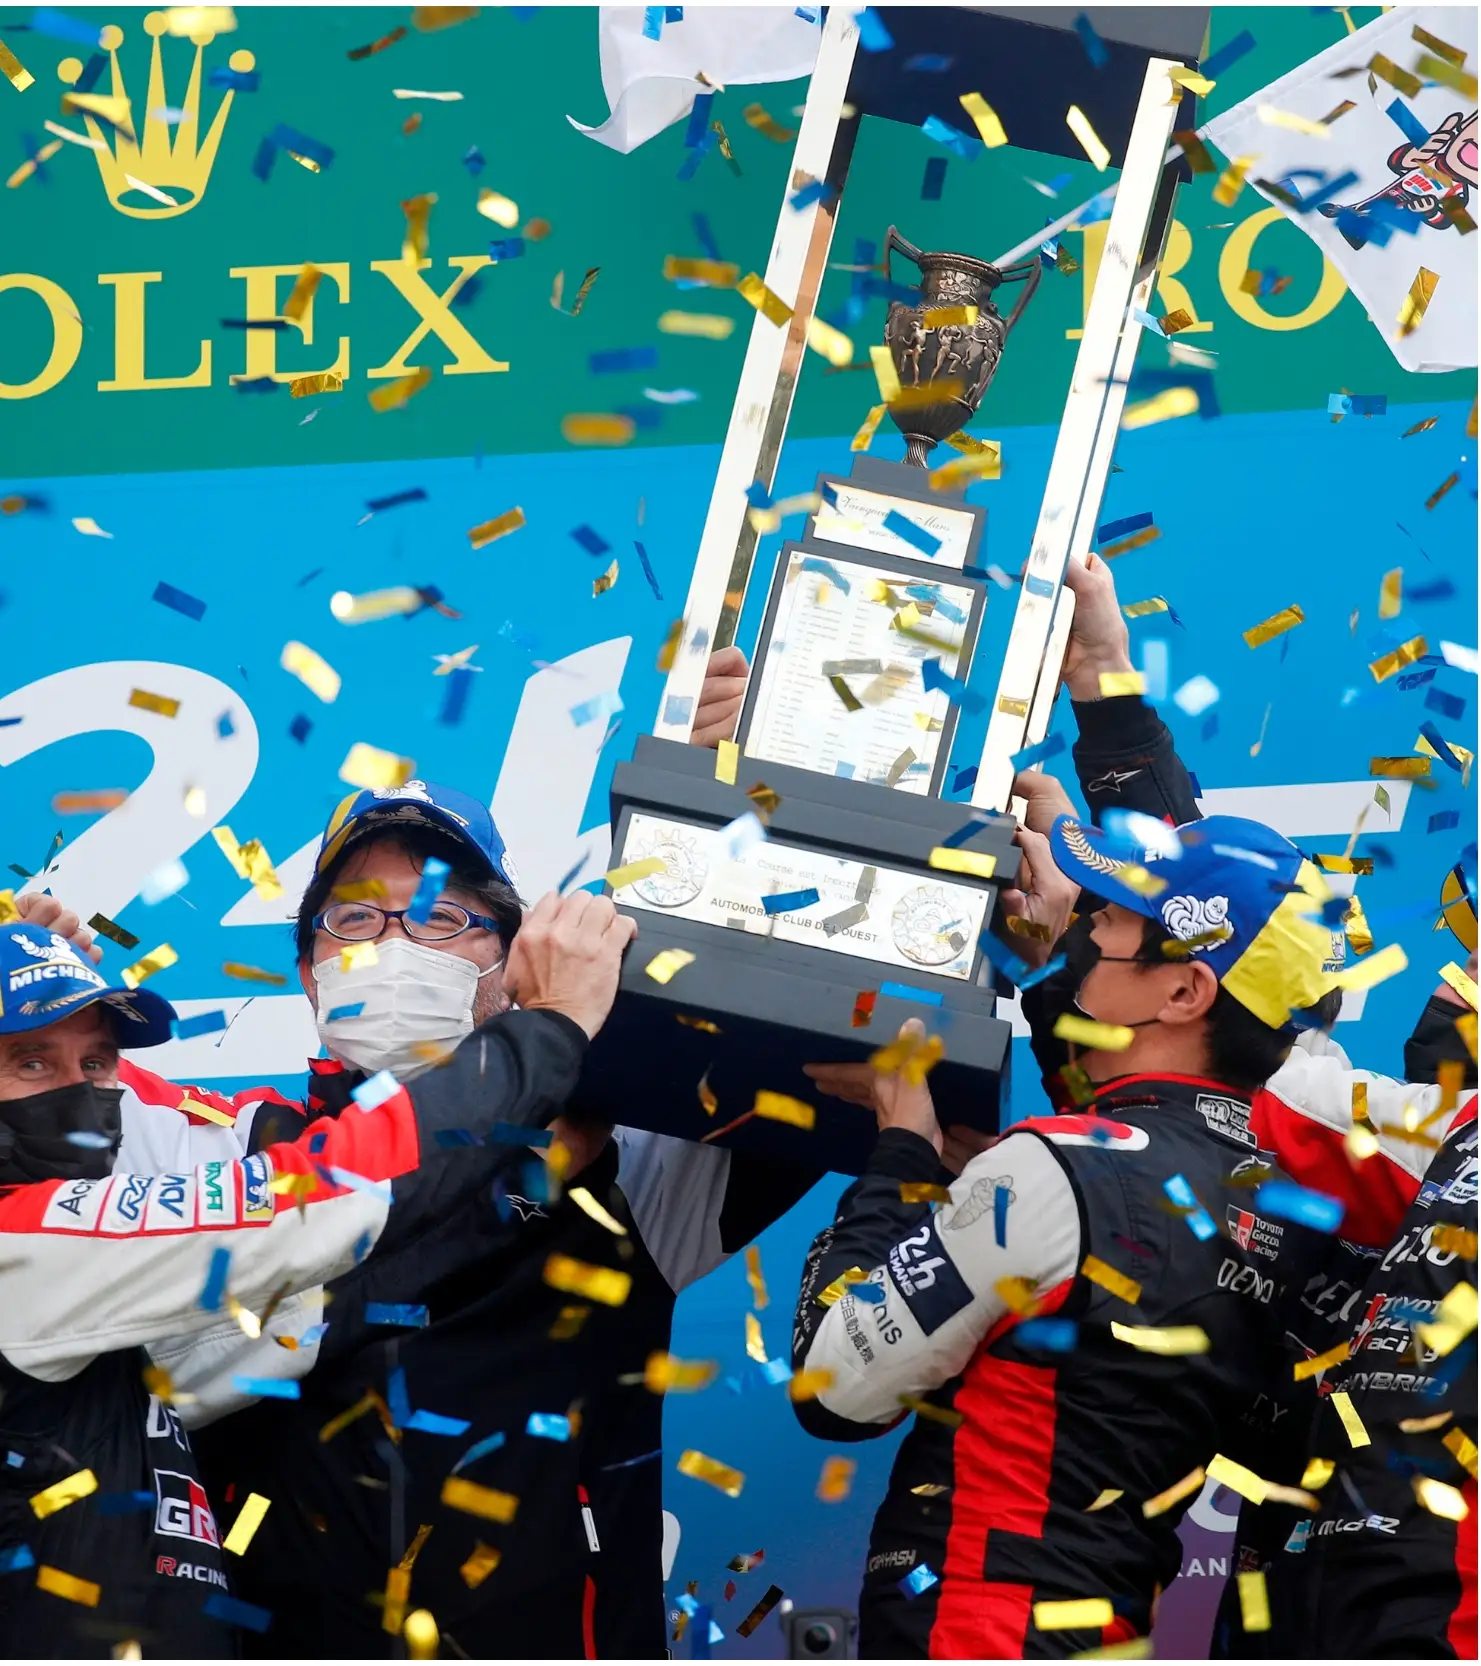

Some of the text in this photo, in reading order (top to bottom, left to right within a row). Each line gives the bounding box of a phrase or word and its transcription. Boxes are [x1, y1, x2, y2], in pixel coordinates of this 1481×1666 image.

[710, 897, 879, 942] AUTOMOBLE CLUB DE L'OUEST
[1255, 1216, 1284, 1236] TOYOTA
[1176, 1557, 1227, 1578] AN
